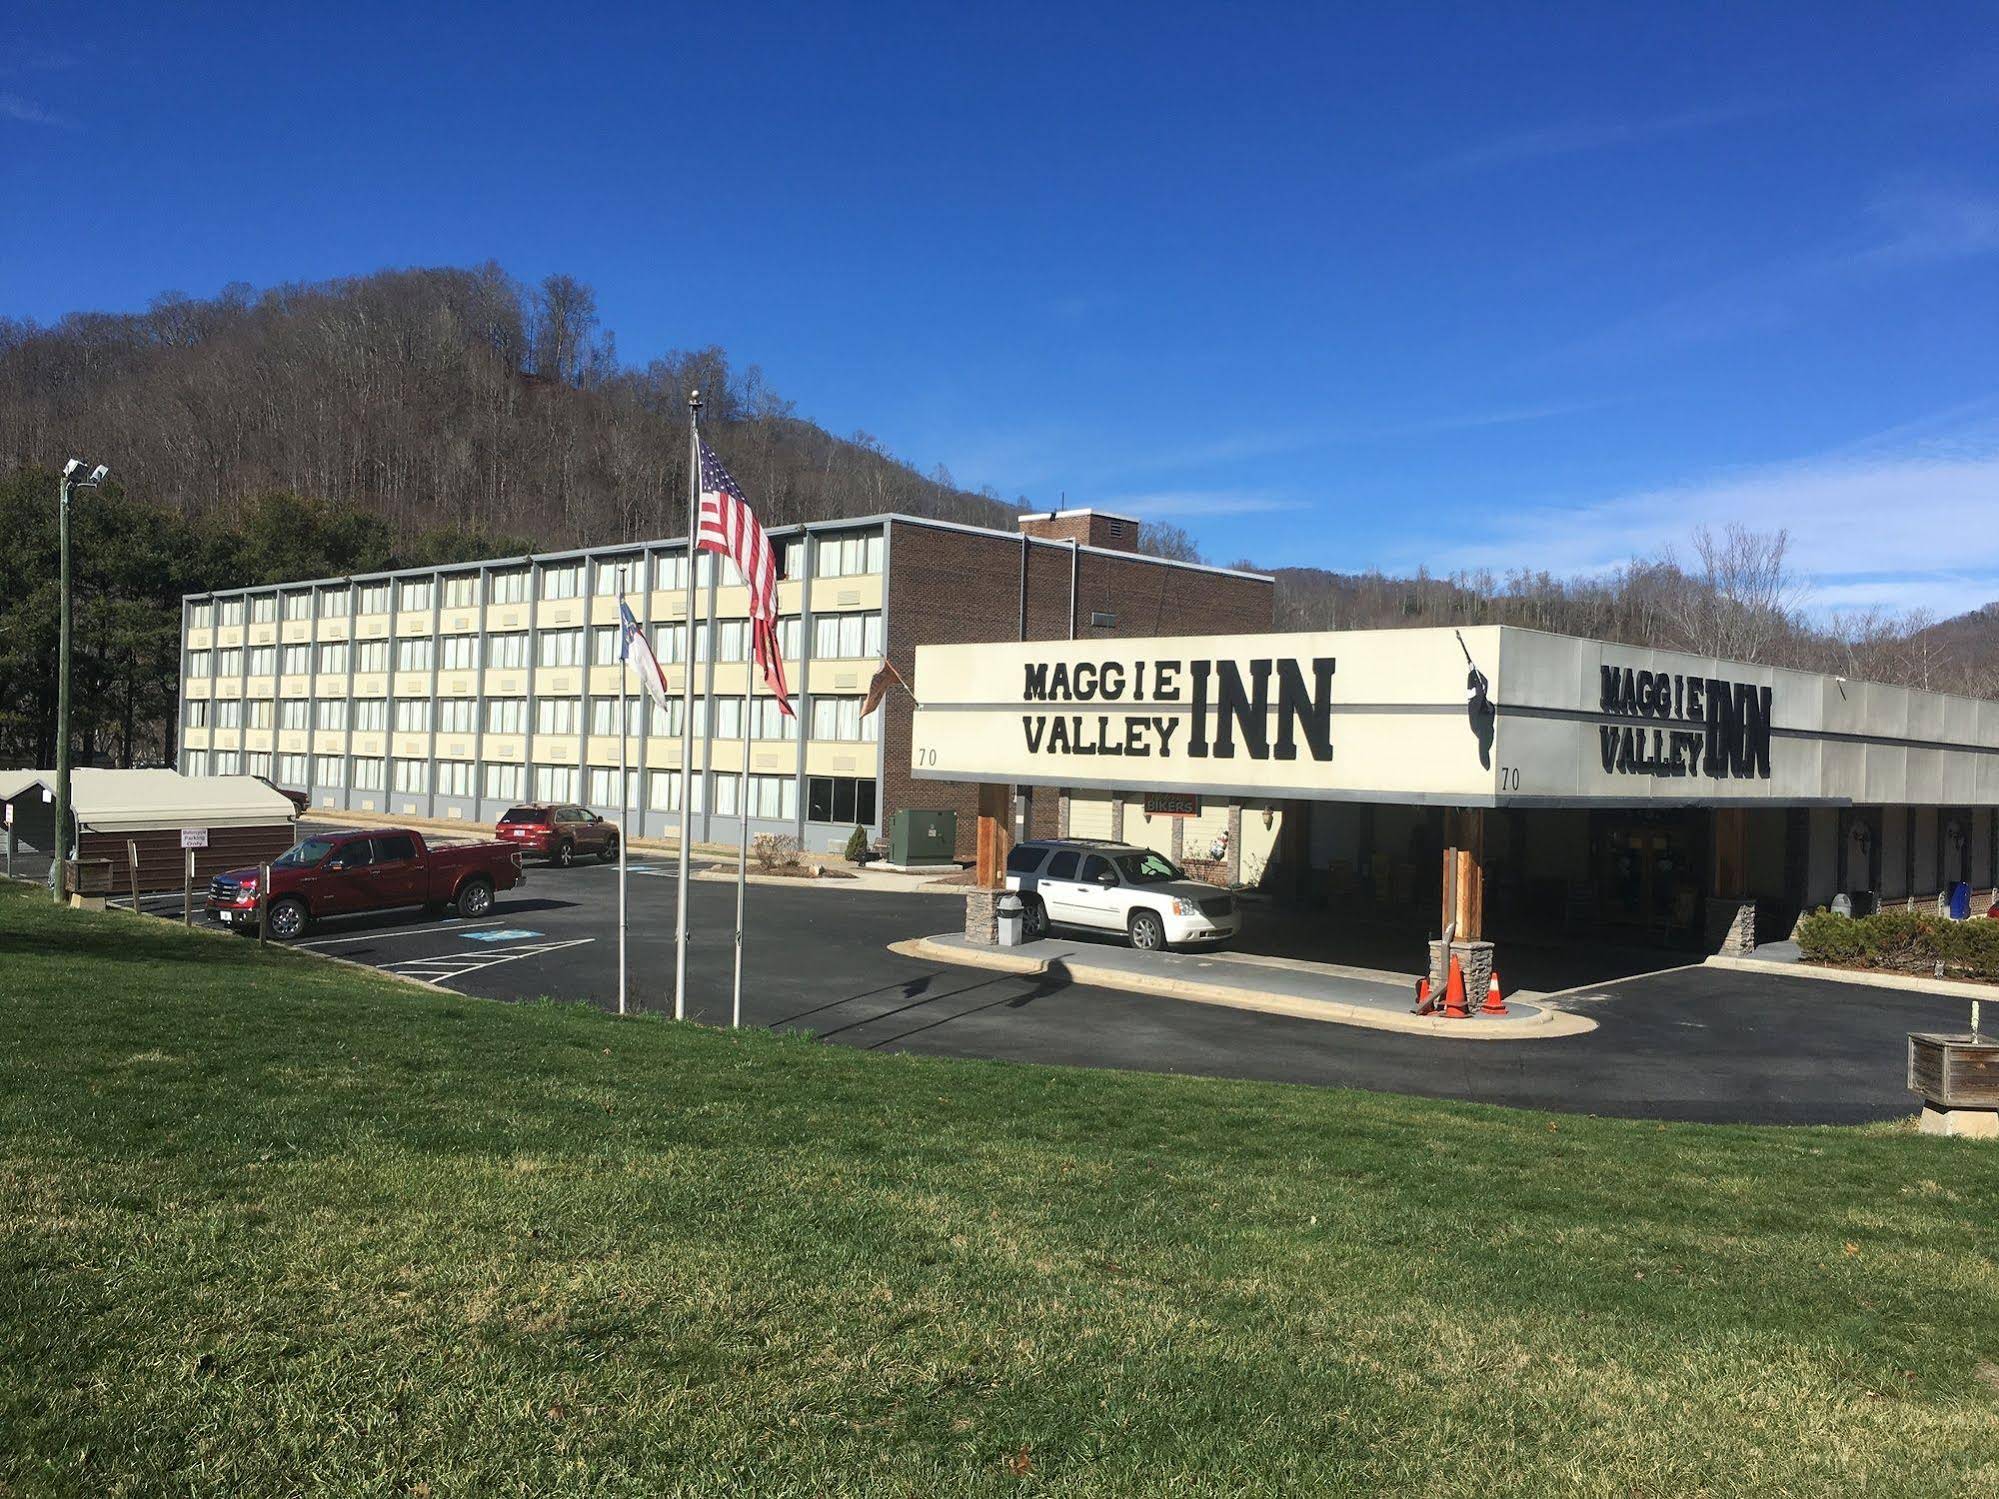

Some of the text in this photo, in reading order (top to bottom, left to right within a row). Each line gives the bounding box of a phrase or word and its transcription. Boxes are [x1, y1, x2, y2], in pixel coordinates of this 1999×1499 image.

[1024, 661, 1181, 700] MAGGIE
[1600, 665, 1704, 720] MAGGIE
[1187, 657, 1336, 762] INN
[1703, 678, 1772, 780] INN
[1022, 716, 1179, 757] VALLEY
[1600, 725, 1703, 777] VALLEY
[919, 748, 937, 767] 70
[1501, 767, 1520, 791] 70
[1147, 800, 1193, 812] BIKERS
